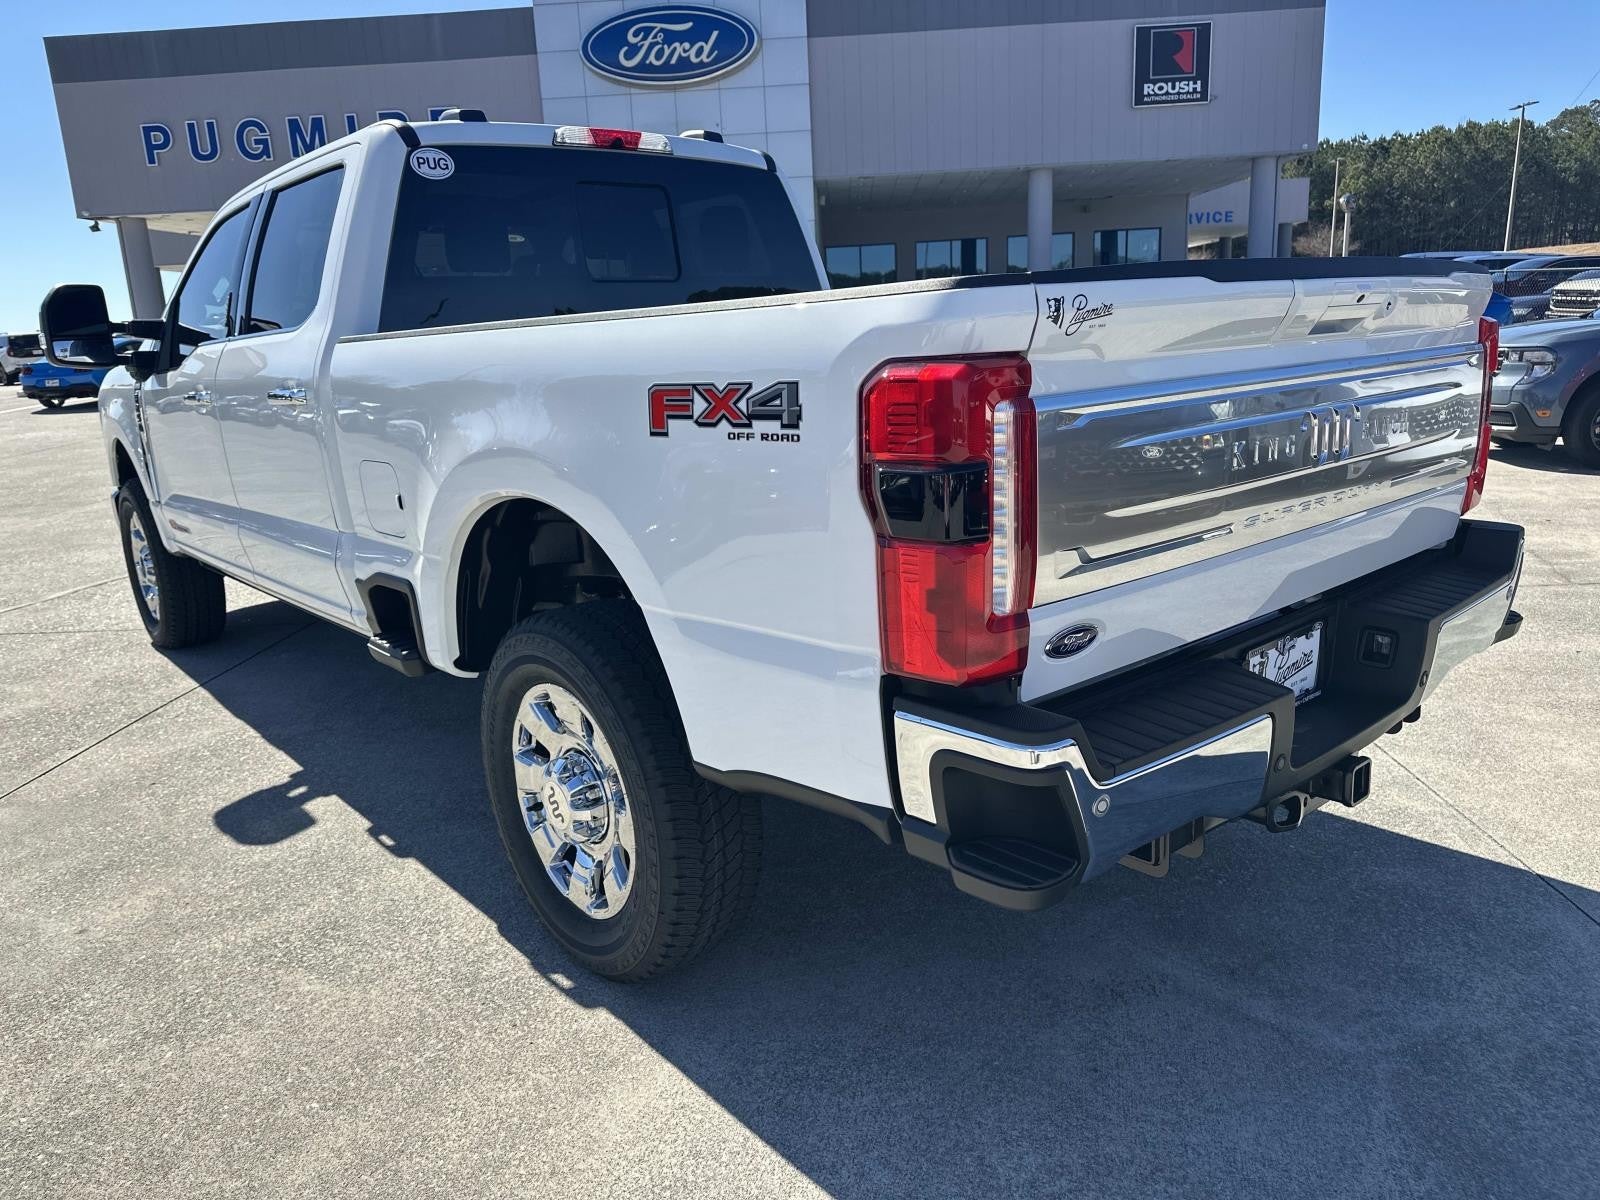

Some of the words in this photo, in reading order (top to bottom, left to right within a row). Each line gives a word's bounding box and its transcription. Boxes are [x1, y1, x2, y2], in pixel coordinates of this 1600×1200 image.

[618, 21, 719, 68] Ford
[1143, 80, 1201, 95] ROUSH
[140, 107, 458, 167] PUGM
[416, 156, 449, 170] PUG
[1065, 294, 1113, 336] Pugmire
[648, 380, 803, 437] FX4
[728, 432, 755, 441] OFF
[760, 433, 801, 442] ROAD
[1231, 434, 1296, 471] KING
[1243, 496, 1328, 529] SUPER
[1060, 632, 1091, 651] Ford
